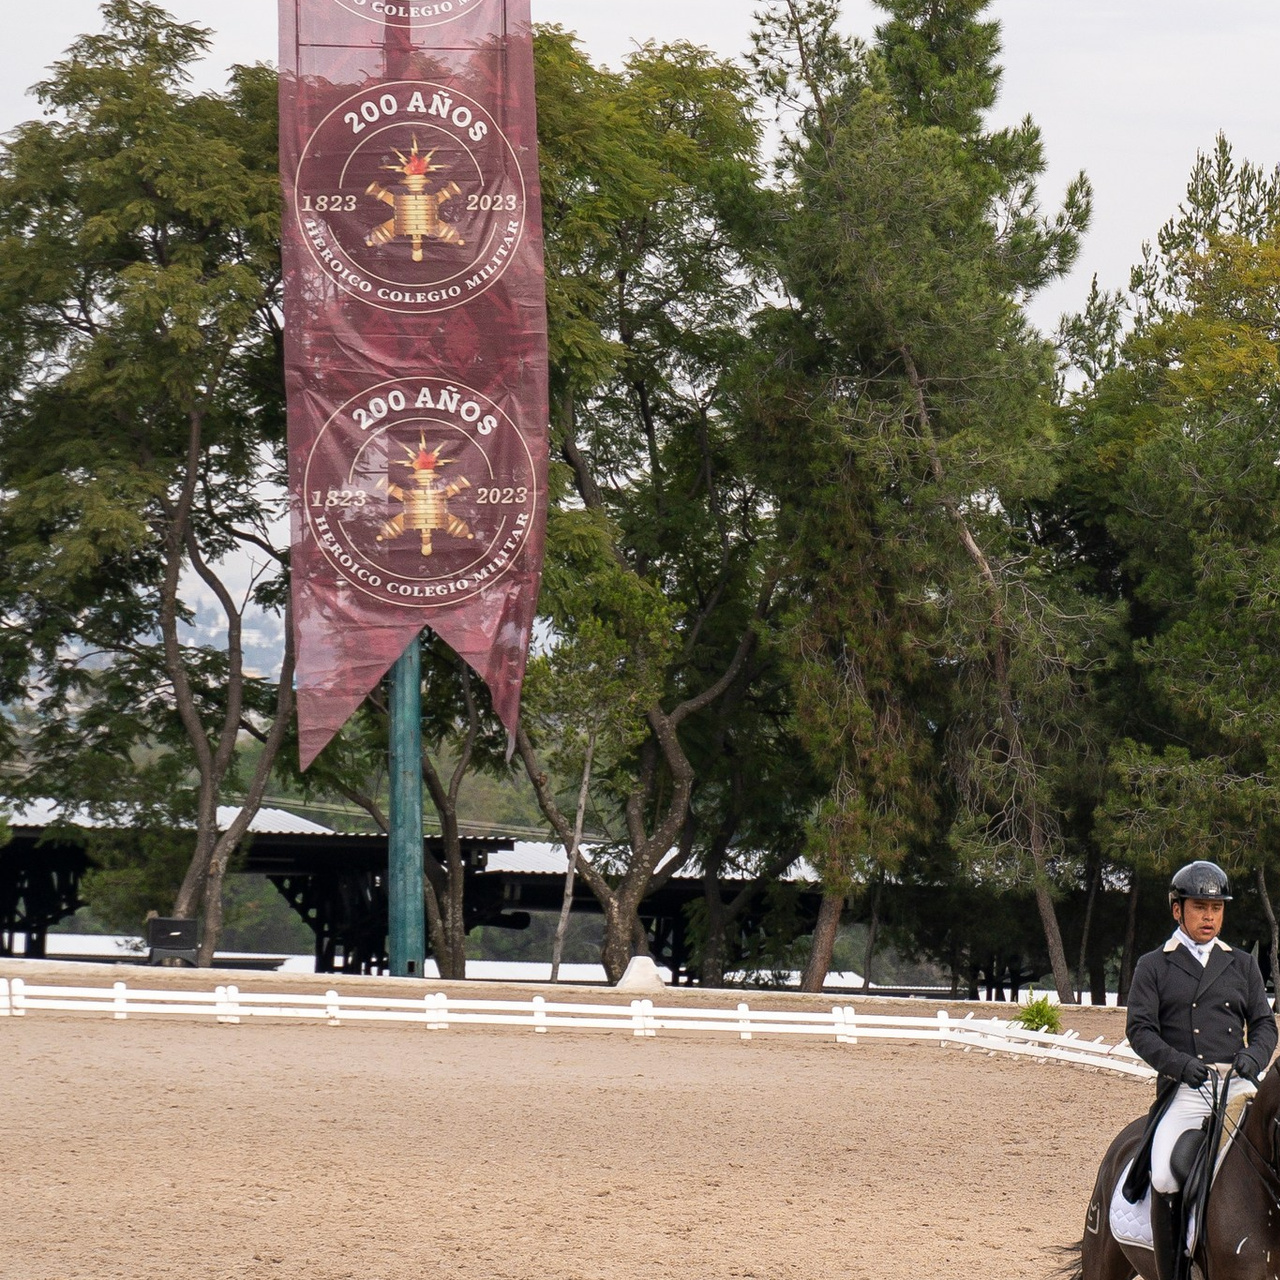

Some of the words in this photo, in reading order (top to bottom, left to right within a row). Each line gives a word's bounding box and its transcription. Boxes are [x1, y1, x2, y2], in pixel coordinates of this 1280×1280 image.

[372, 1, 453, 18] COLEGIO
[344, 94, 397, 134] 200
[407, 90, 488, 142] AÑOS
[301, 195, 357, 212] 1823
[466, 194, 517, 211] 2023
[304, 220, 372, 292] HEROICO
[377, 285, 462, 303] COLEGIO
[464, 219, 519, 291] MILITAR
[352, 390, 405, 430] 200
[414, 385, 498, 436] AÑOS
[310, 490, 367, 507] 1823
[476, 487, 528, 504] 2023
[314, 515, 382, 587] HEROICO
[386, 578, 469, 597] COLEGIO
[474, 512, 530, 583] MILITAR
